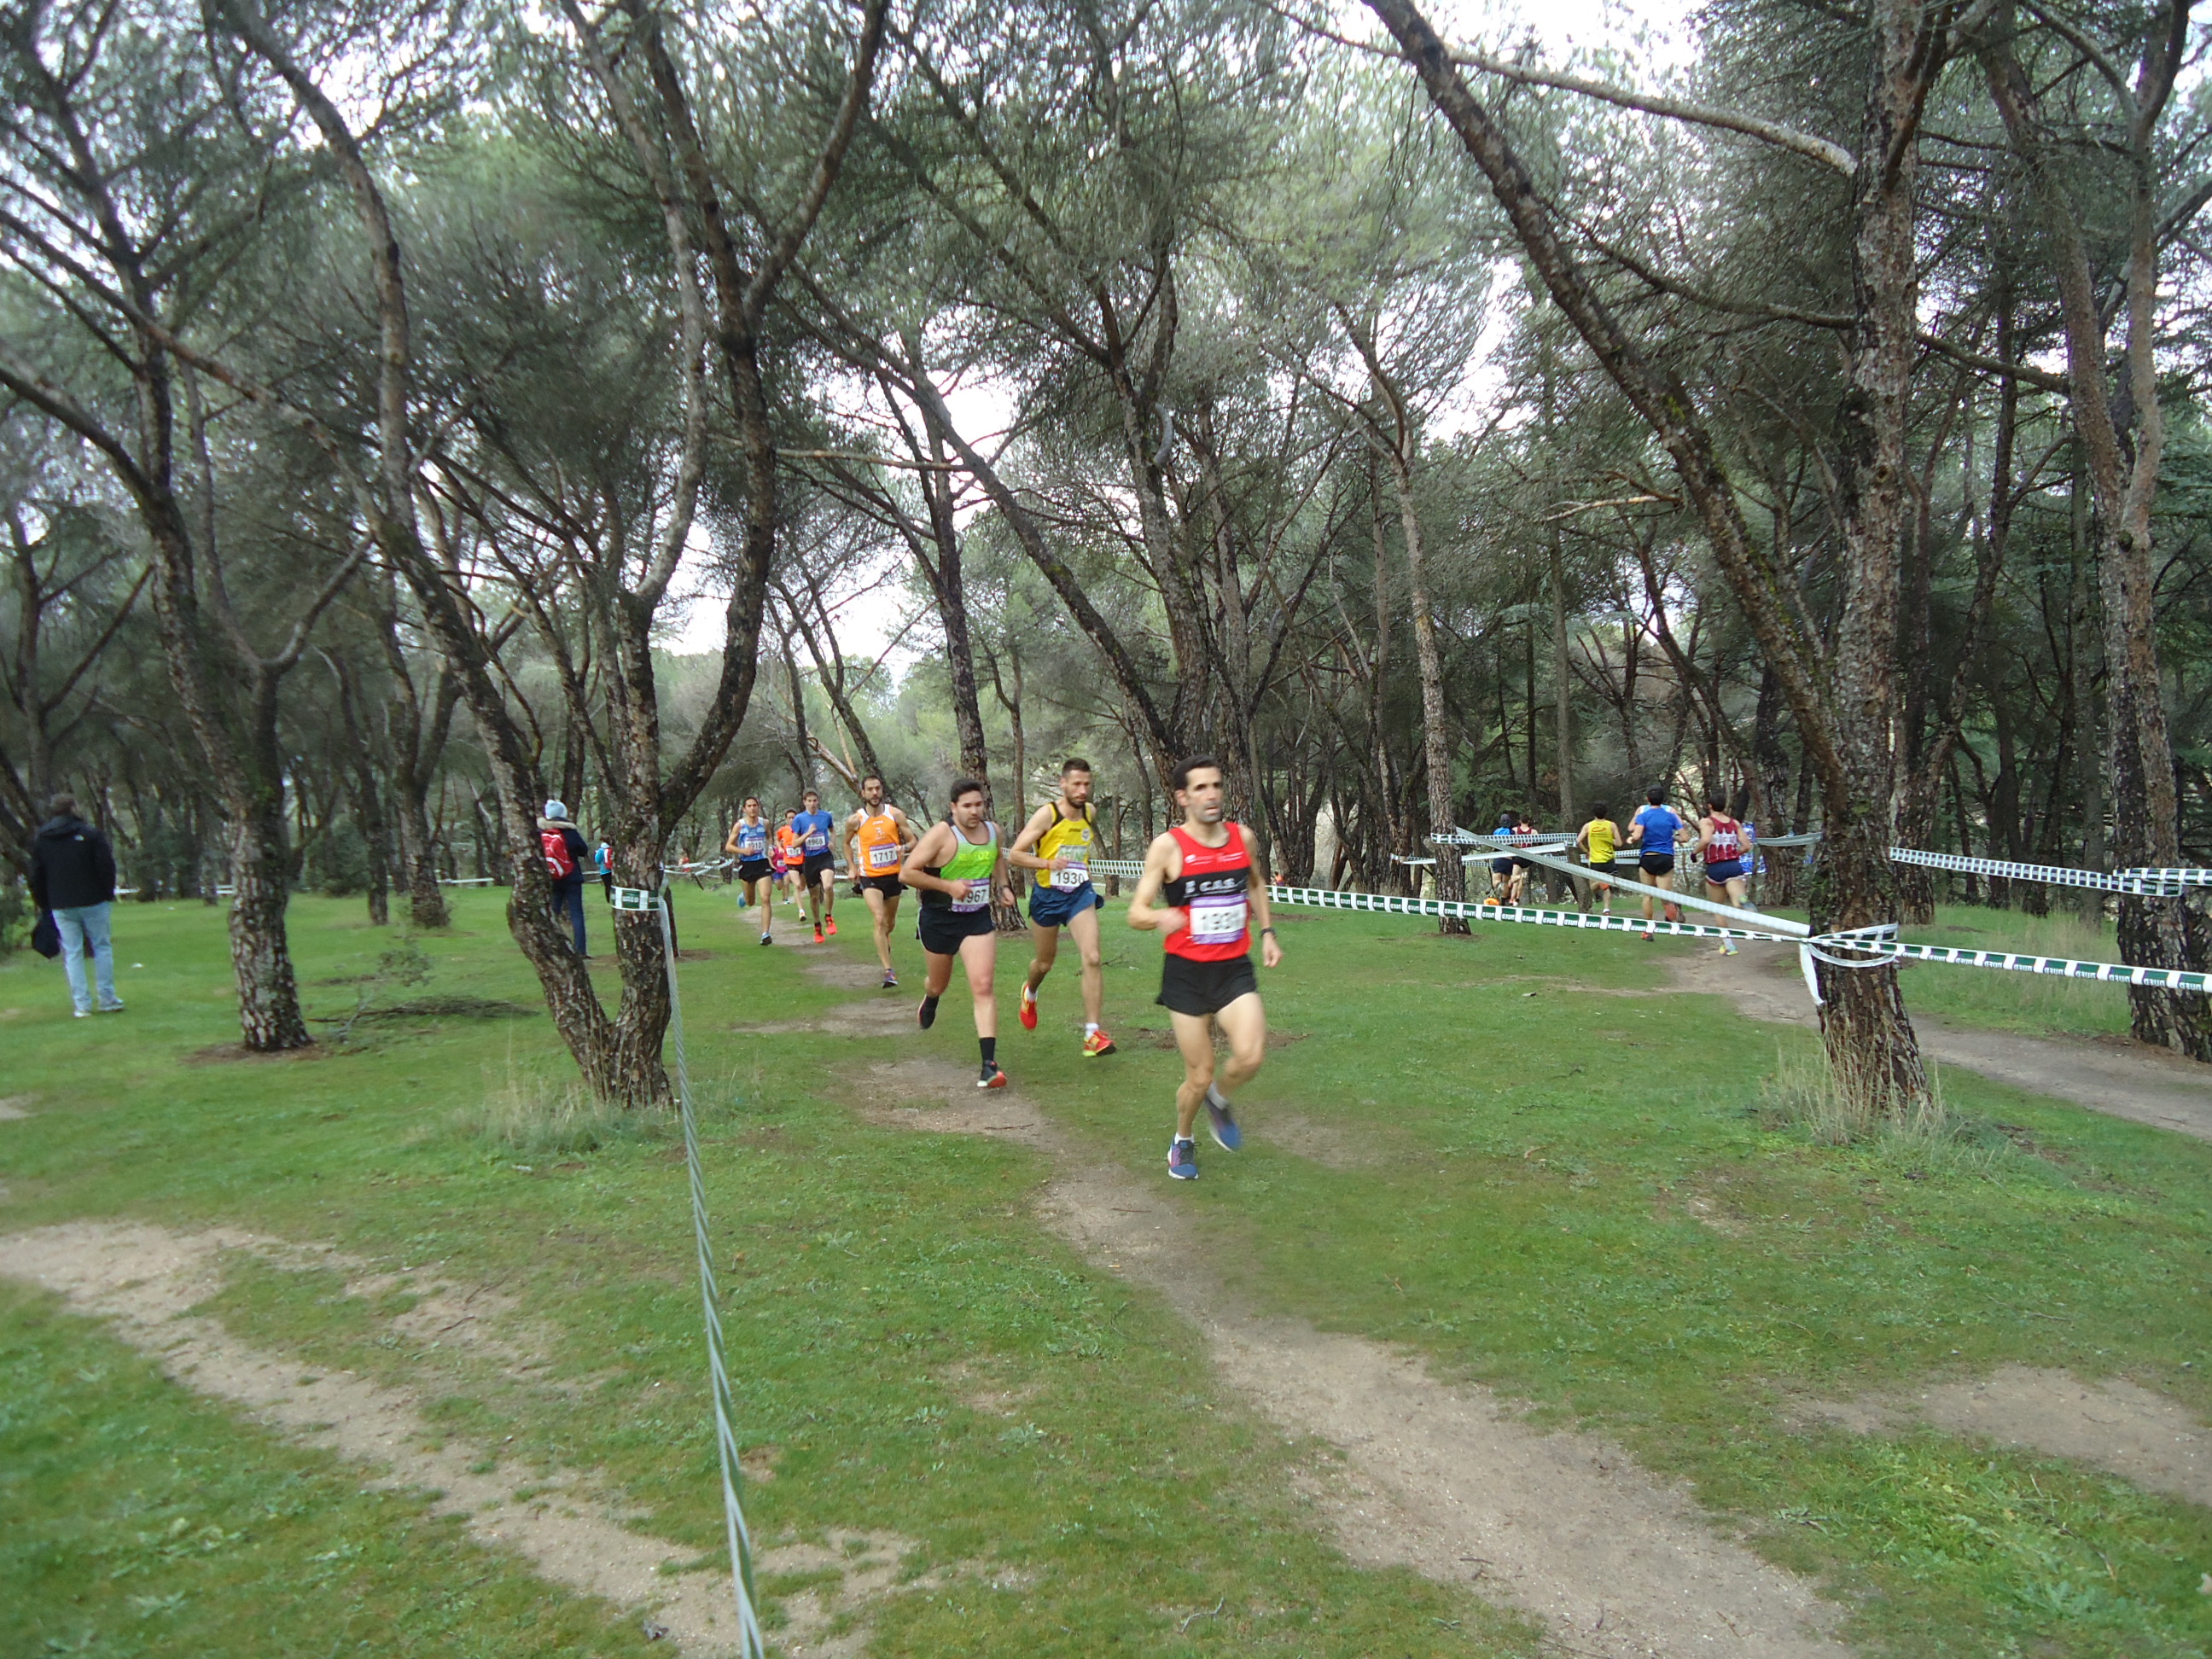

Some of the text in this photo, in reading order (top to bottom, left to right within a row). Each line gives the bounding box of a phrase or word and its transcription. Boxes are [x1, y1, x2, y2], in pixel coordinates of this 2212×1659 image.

[874, 851, 893, 862] 1717
[1057, 872, 1085, 884] 1930
[961, 889, 986, 903] 967
